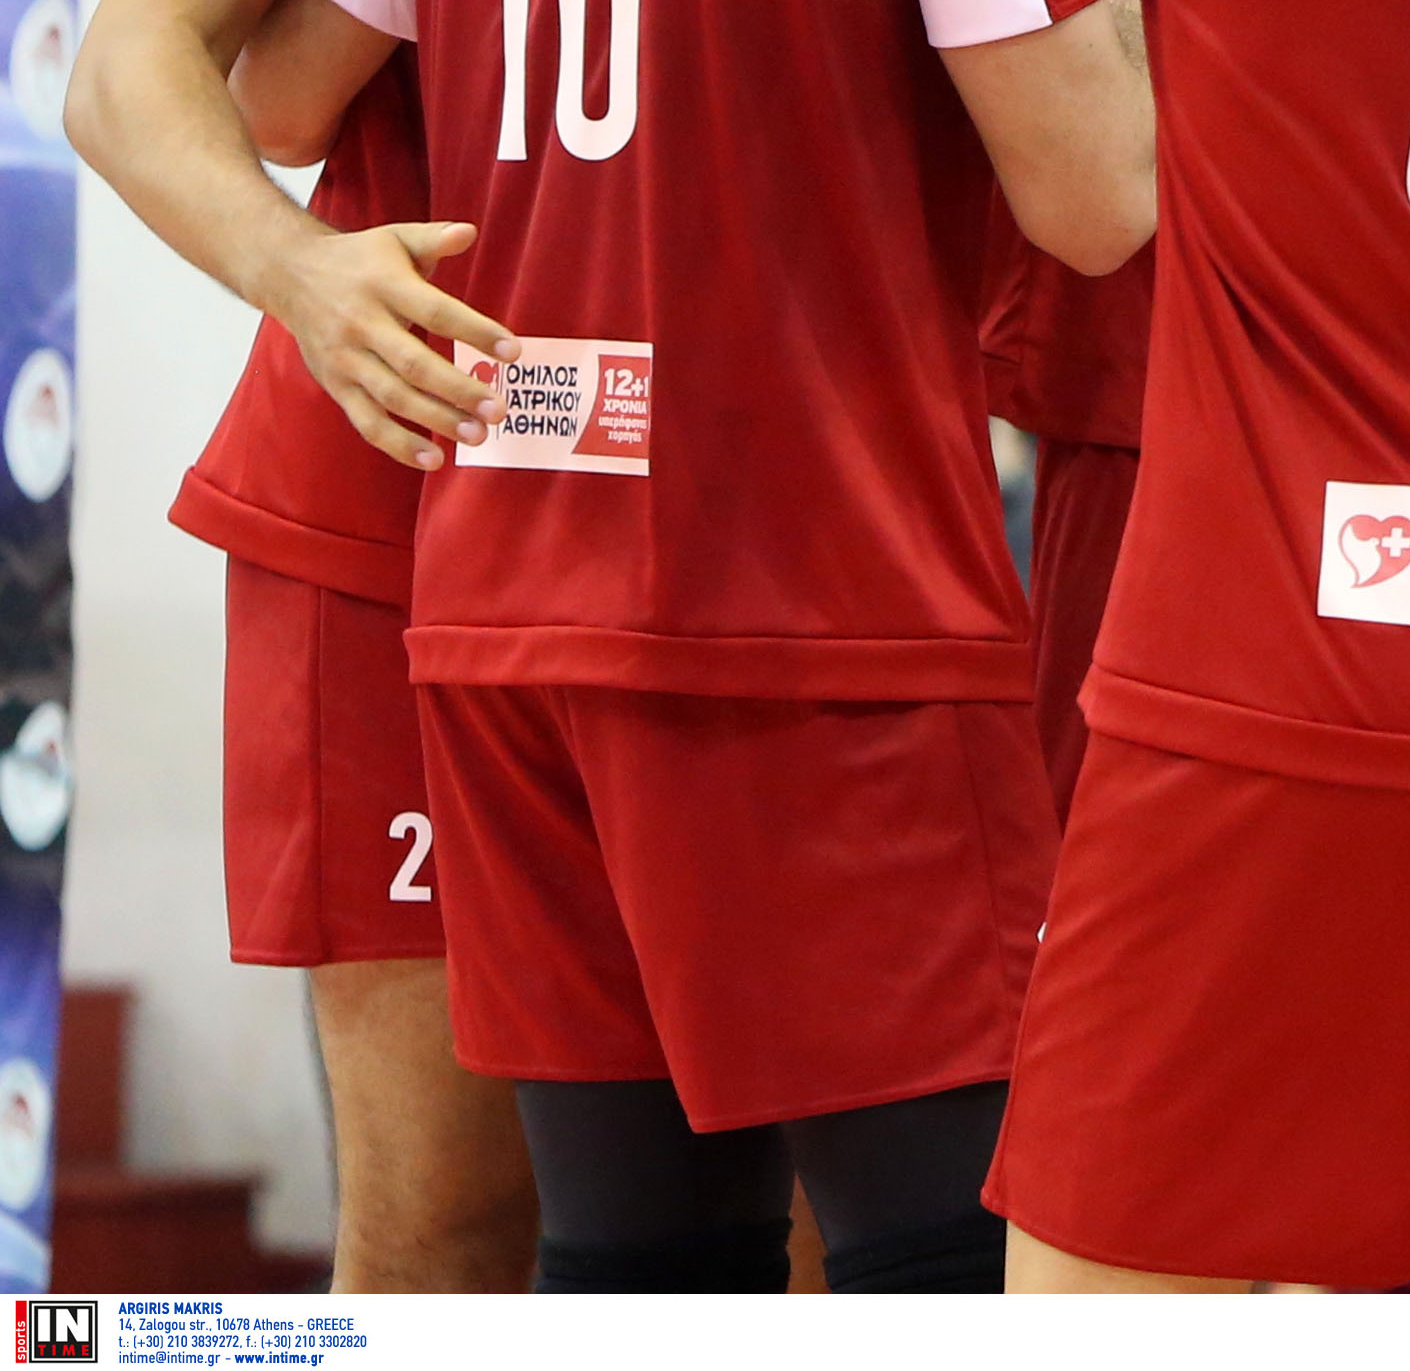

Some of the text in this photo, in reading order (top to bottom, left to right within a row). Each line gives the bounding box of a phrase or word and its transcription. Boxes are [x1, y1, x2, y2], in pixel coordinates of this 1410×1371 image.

[506, 364, 577, 387] ΟΜΙΛΟΣ
[604, 368, 649, 397] 12+1
[603, 398, 648, 414] ΧΡΟΝΙΑ
[503, 414, 577, 436] ΑΘΗΝΩΝ
[389, 812, 433, 902] 2
